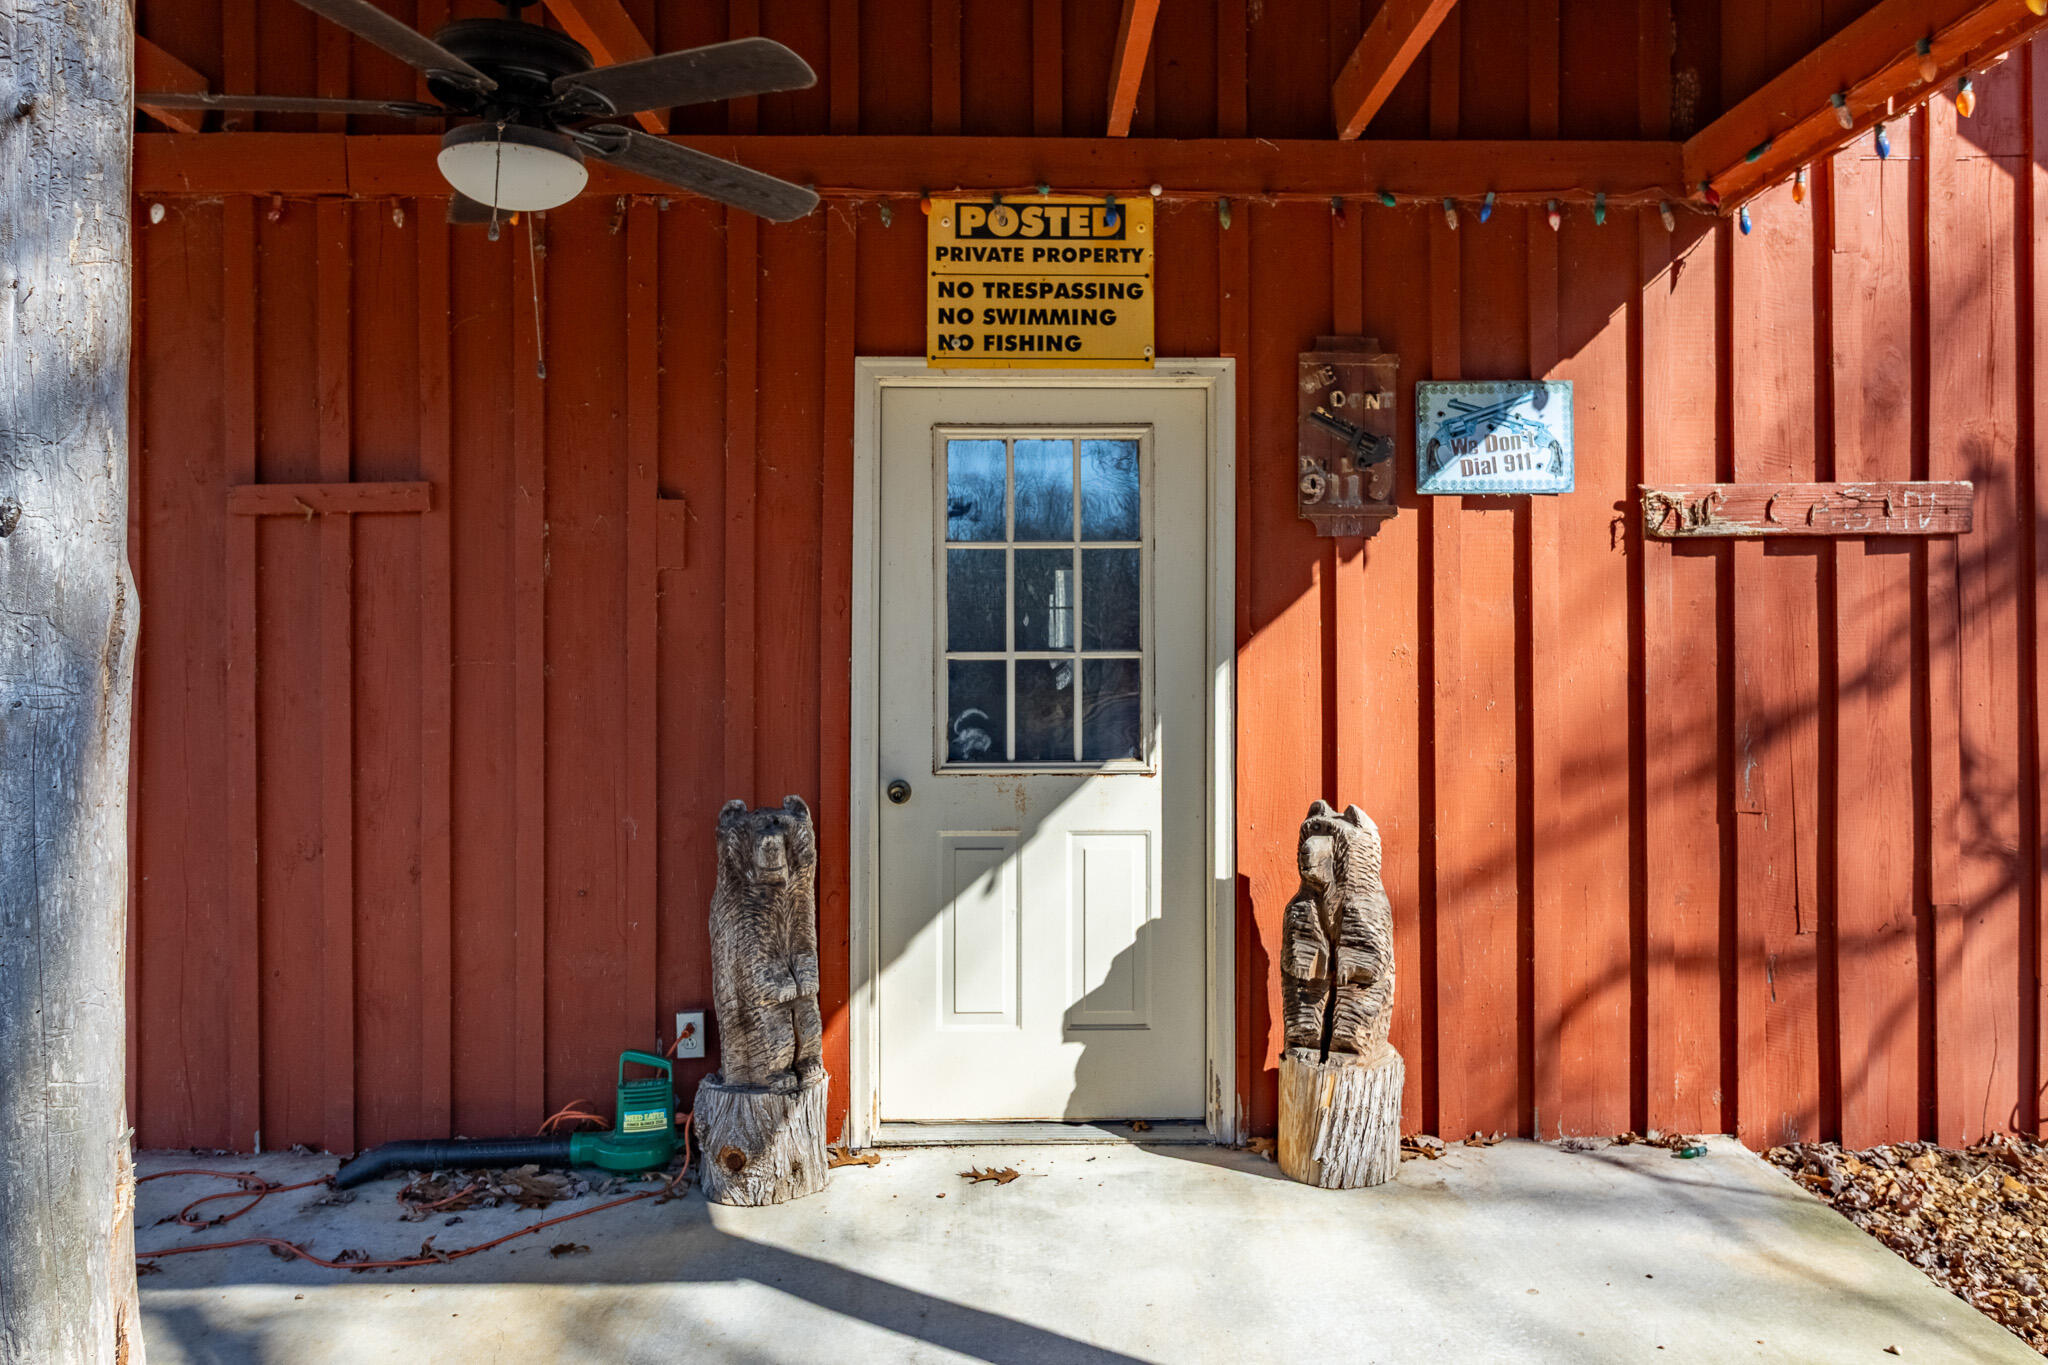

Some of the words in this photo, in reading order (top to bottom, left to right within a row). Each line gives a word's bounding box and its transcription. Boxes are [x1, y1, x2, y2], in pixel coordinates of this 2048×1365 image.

[959, 205, 1121, 237] POSTED
[935, 246, 1024, 263] PRIVATE
[1032, 247, 1145, 264] PROPERTY
[938, 281, 974, 298] NO
[983, 282, 1144, 300] TRESPASSING
[938, 308, 974, 325] NO
[983, 308, 1117, 326] SWIMMING
[938, 334, 974, 351] NO
[983, 334, 1082, 352] FISHING
[1450, 437, 1479, 455] We
[1485, 432, 1536, 453] Don't
[1460, 455, 1498, 477] Dial
[1504, 453, 1532, 473] 911
[1300, 472, 1362, 505] 911
